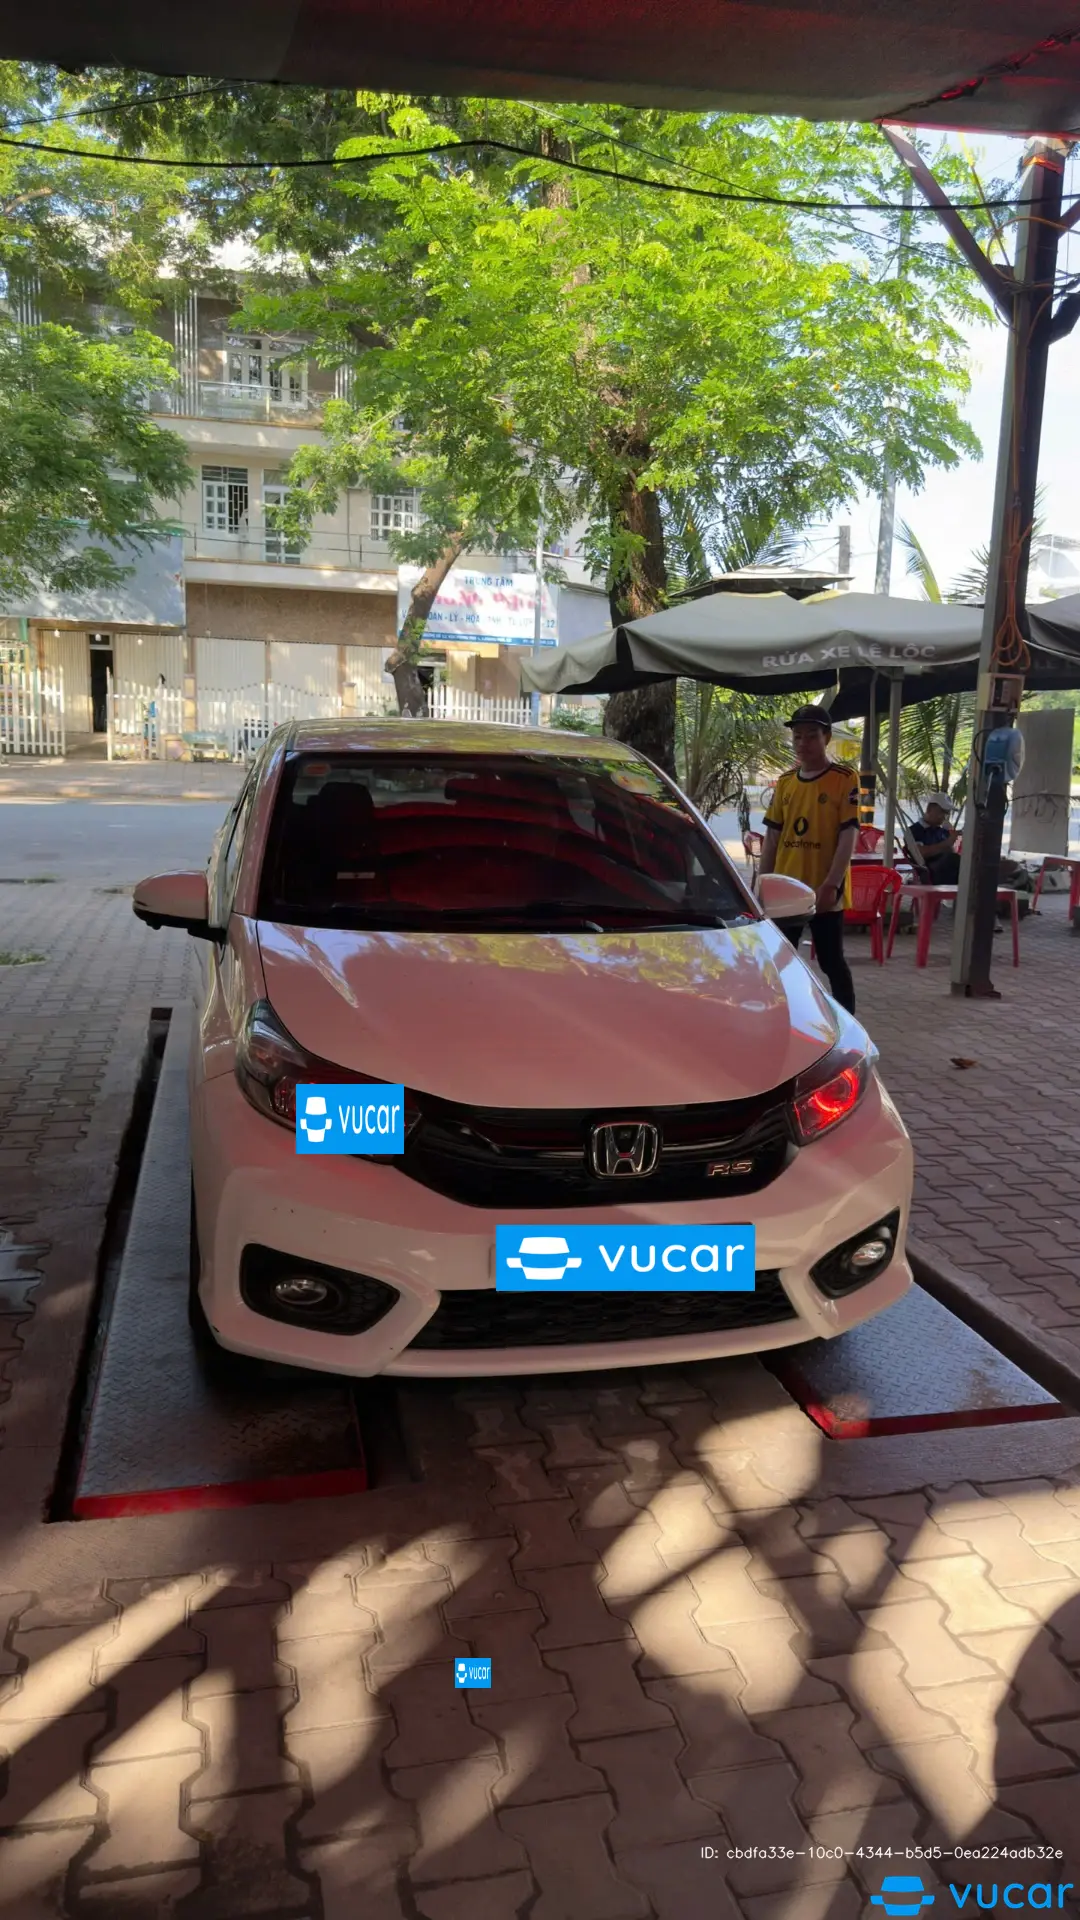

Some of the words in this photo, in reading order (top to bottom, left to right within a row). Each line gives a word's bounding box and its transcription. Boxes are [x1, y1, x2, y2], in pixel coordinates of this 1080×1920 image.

[495, 576, 513, 587] TÂM
[762, 650, 814, 667] RỬA
[821, 645, 850, 660] XE
[857, 643, 882, 658] LÊ
[888, 642, 937, 660] LỘC
[708, 1160, 753, 1176] RS
